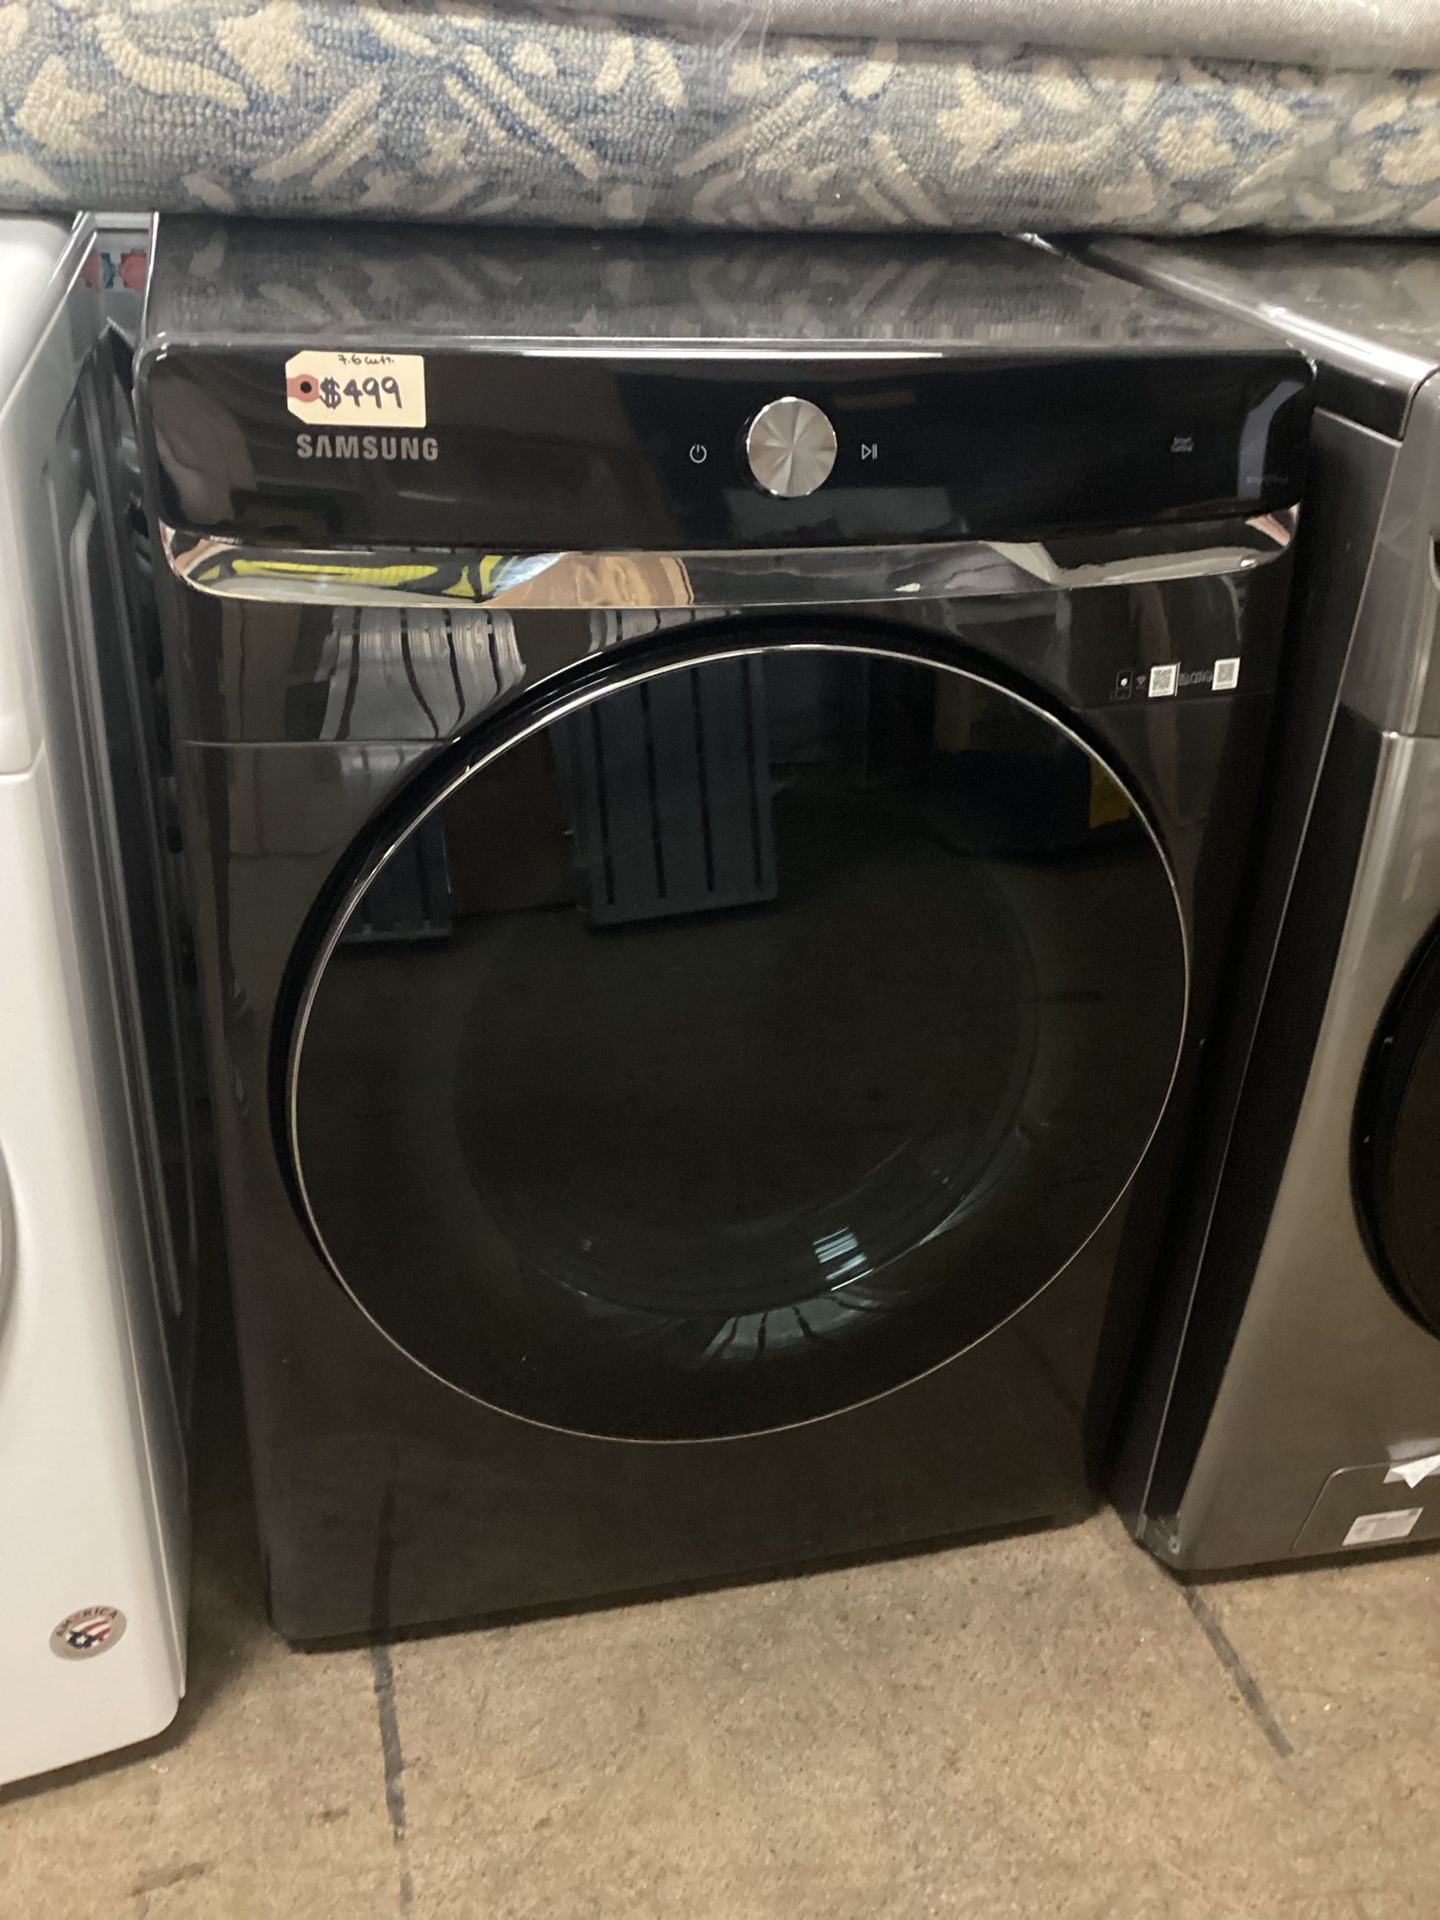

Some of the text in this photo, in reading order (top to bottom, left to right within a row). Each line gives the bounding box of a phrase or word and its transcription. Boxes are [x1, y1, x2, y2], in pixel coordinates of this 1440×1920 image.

[337, 354, 362, 365] 7.6
[320, 376, 402, 410] $499
[296, 433, 439, 461] SAMSUNG
